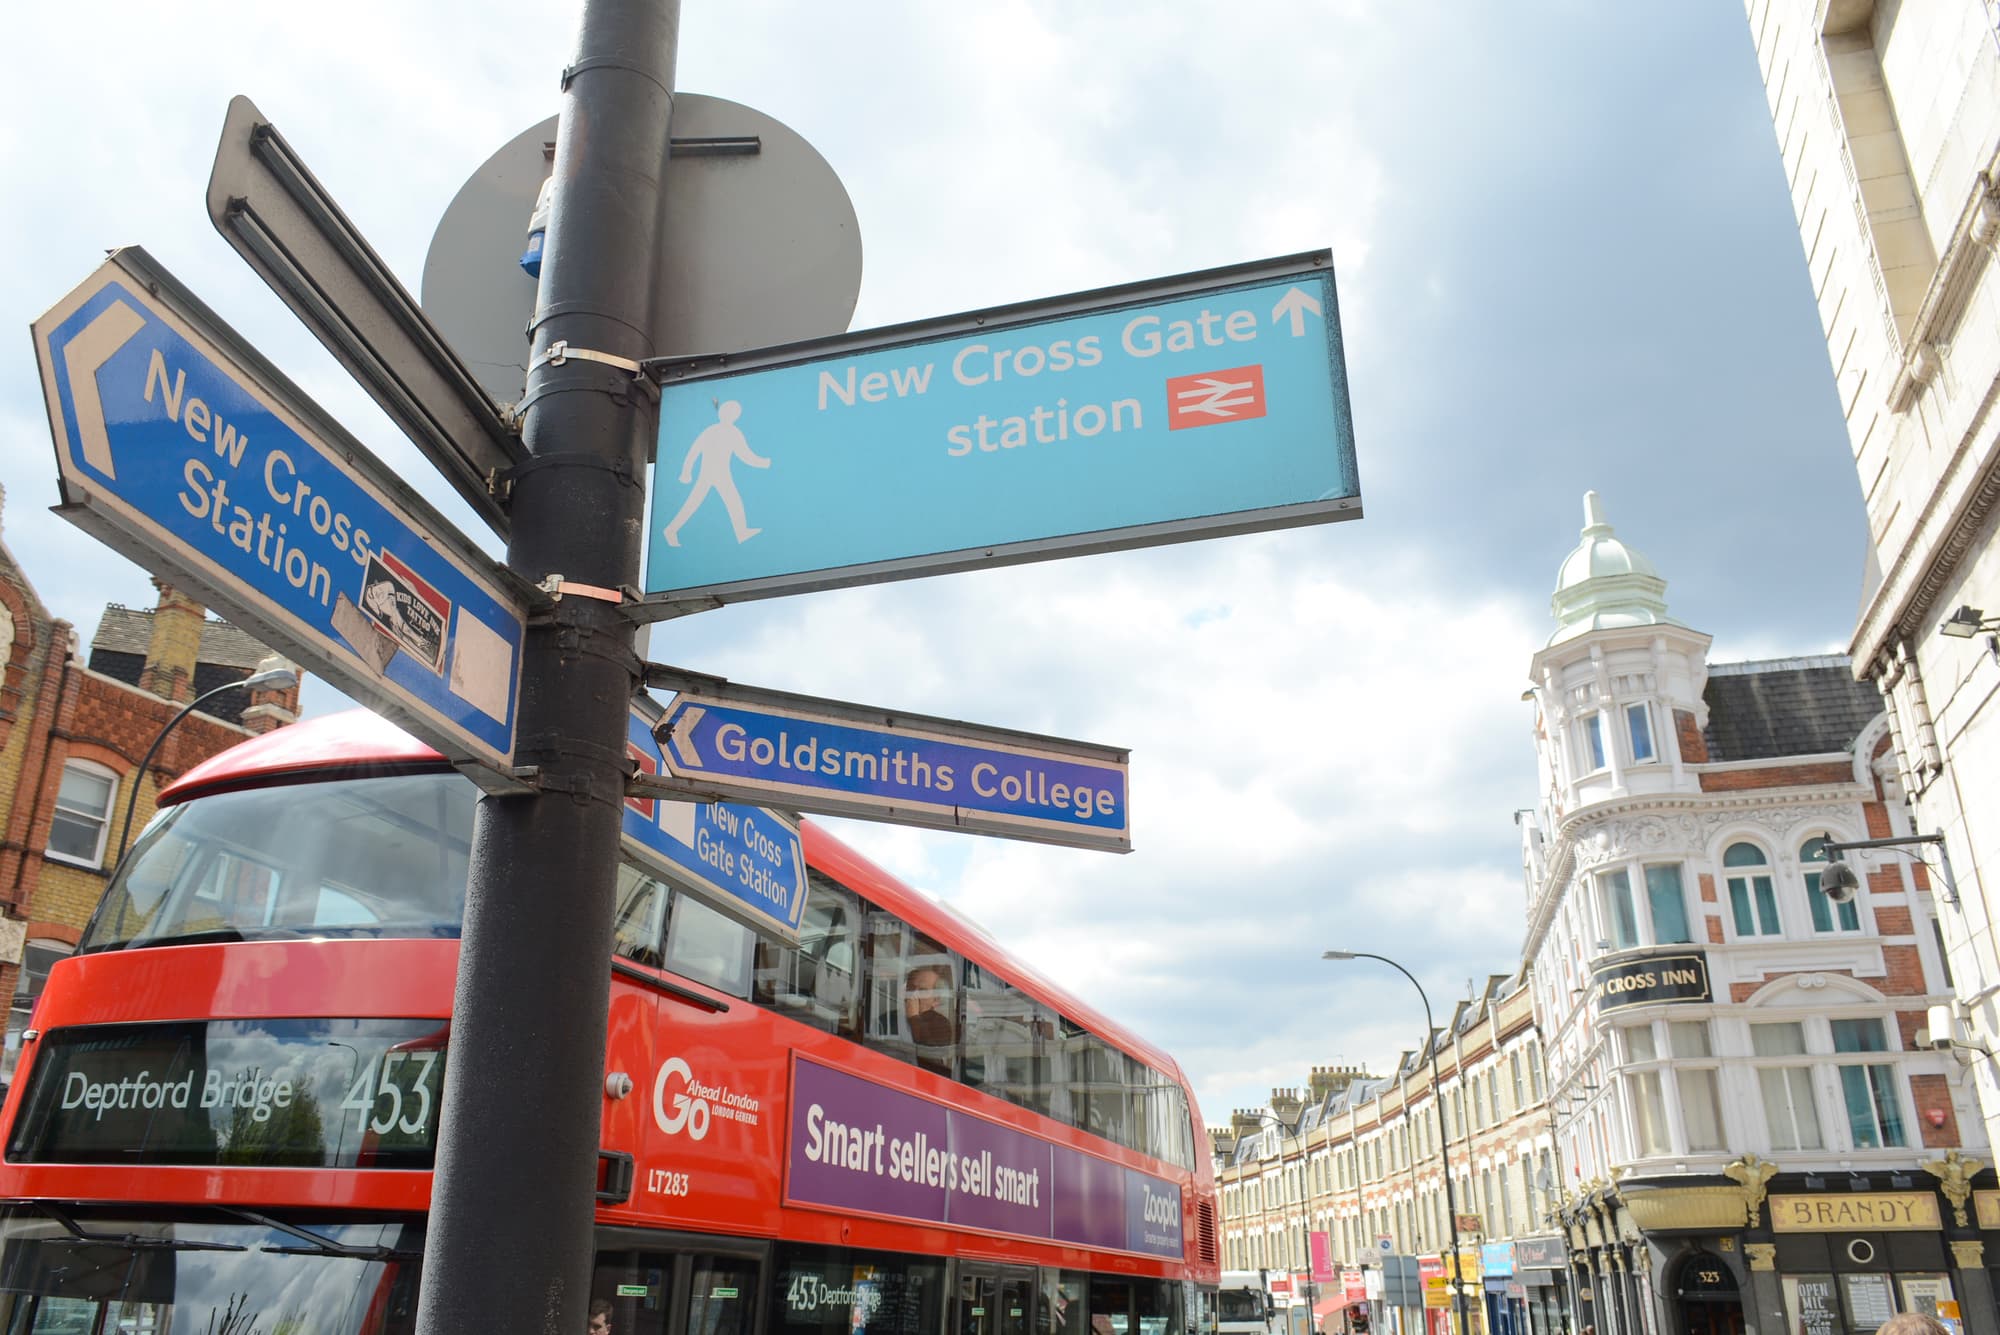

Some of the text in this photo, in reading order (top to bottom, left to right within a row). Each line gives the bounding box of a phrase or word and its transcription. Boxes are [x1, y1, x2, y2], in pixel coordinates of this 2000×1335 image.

[818, 309, 1258, 410] New Cross Gate
[144, 348, 371, 566] New Cross
[947, 398, 1143, 457] station
[178, 458, 332, 607] Station
[714, 722, 1116, 819] Goldsmiths College
[706, 801, 783, 868] New Cross
[697, 827, 788, 909] Gate Station
[1606, 972, 1657, 995] CROSS
[1661, 969, 1697, 986] INN
[61, 1051, 439, 1136] Deptford Bridge 453
[653, 1056, 710, 1141] Go
[686, 1079, 759, 1112] Ahead London
[711, 1104, 759, 1126] LONDON GENERAL
[647, 1168, 689, 1197] LT283
[804, 1103, 1040, 1209] Smart sellers sell smart
[1143, 1184, 1179, 1233] Zoopla
[1793, 1199, 1917, 1224] BRANDY
[786, 1275, 819, 1311] 453
[820, 1283, 857, 1311] Deptford
[1798, 1283, 1829, 1297] OPEN
[1802, 1296, 1825, 1309] MIC
